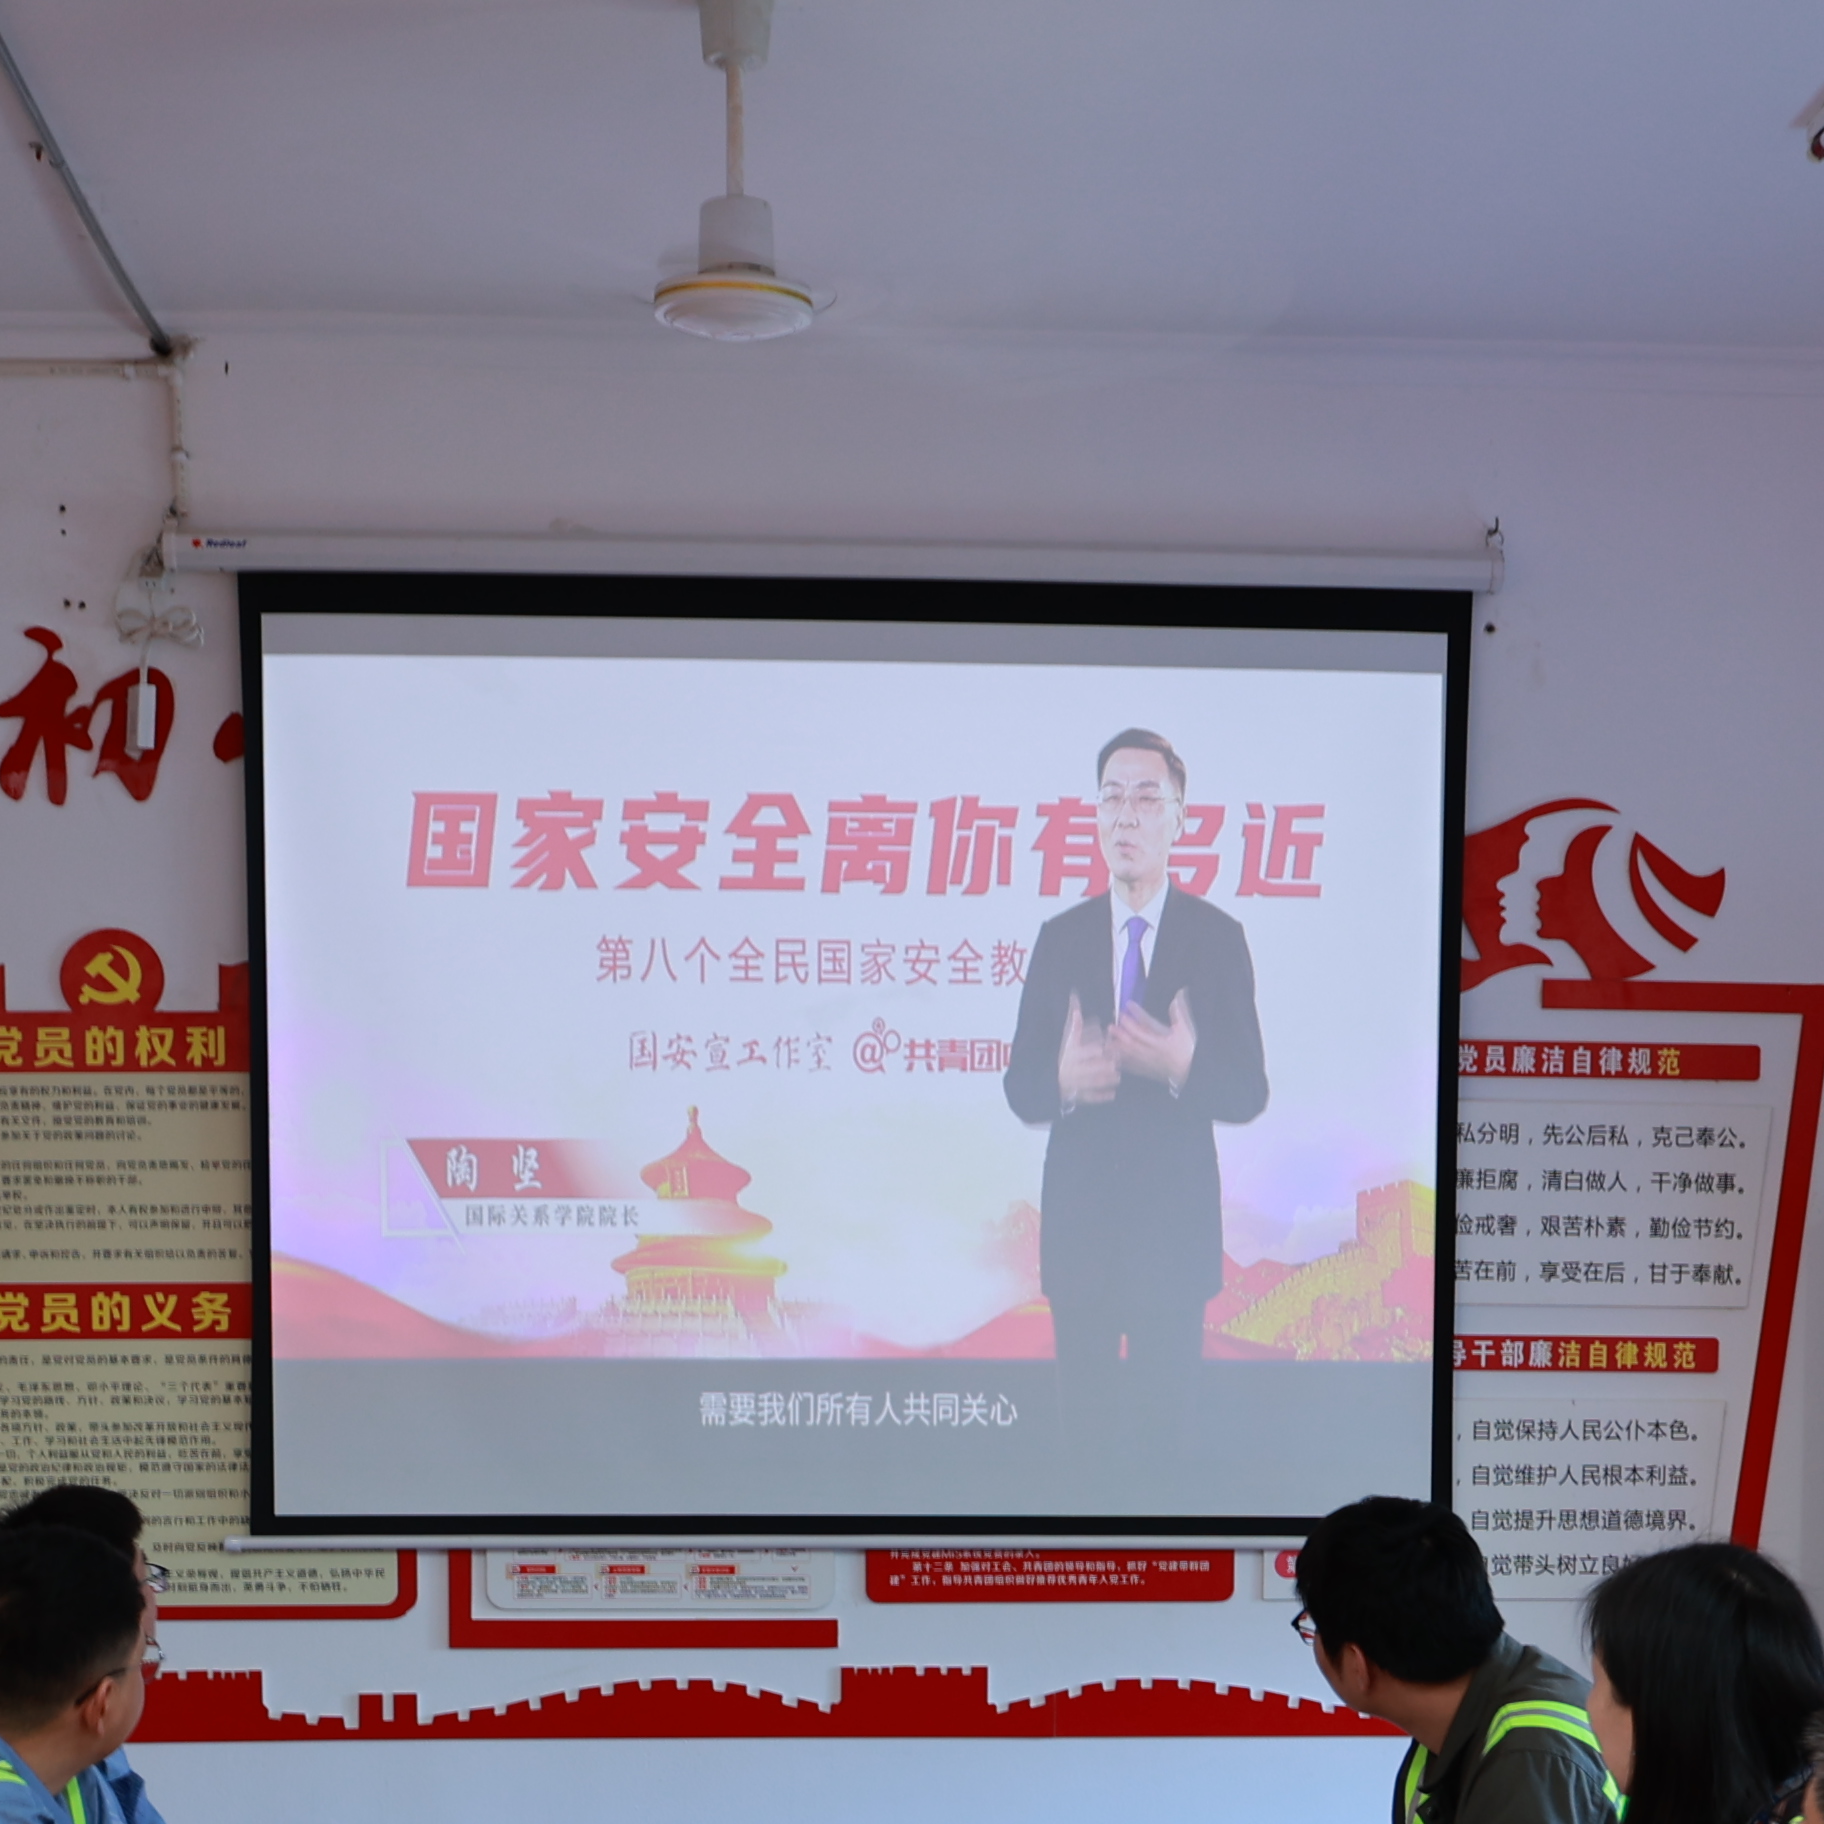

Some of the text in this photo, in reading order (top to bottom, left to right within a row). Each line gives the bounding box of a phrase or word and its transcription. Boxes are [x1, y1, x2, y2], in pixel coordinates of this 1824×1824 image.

[405, 789, 1327, 900] 国家安全离你有多近
[593, 934, 1028, 989] 第八个全民国家安全教
[628, 1031, 835, 1073] 国安宣工作室
[1458, 1044, 1681, 1077] 党员廉洁自律规范
[464, 1202, 641, 1229] 国际关系学院院长
[698, 1390, 1019, 1429] 需要我们所有人共同关心
